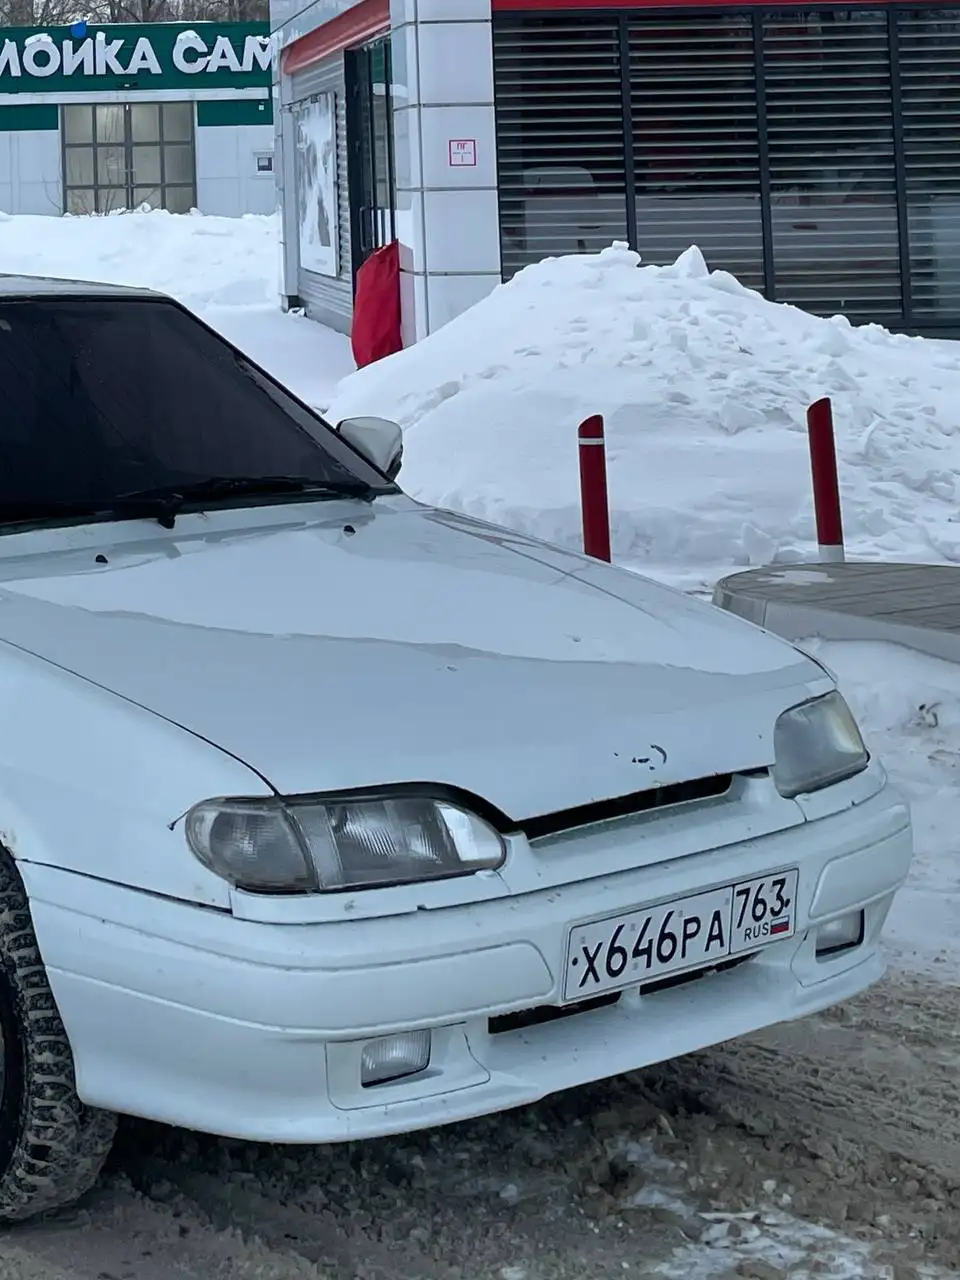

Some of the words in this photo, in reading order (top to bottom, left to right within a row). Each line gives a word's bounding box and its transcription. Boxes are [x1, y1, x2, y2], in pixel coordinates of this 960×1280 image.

[578, 909, 725, 988] Х646РА
[735, 877, 787, 929] 763
[743, 921, 770, 942] RUS
